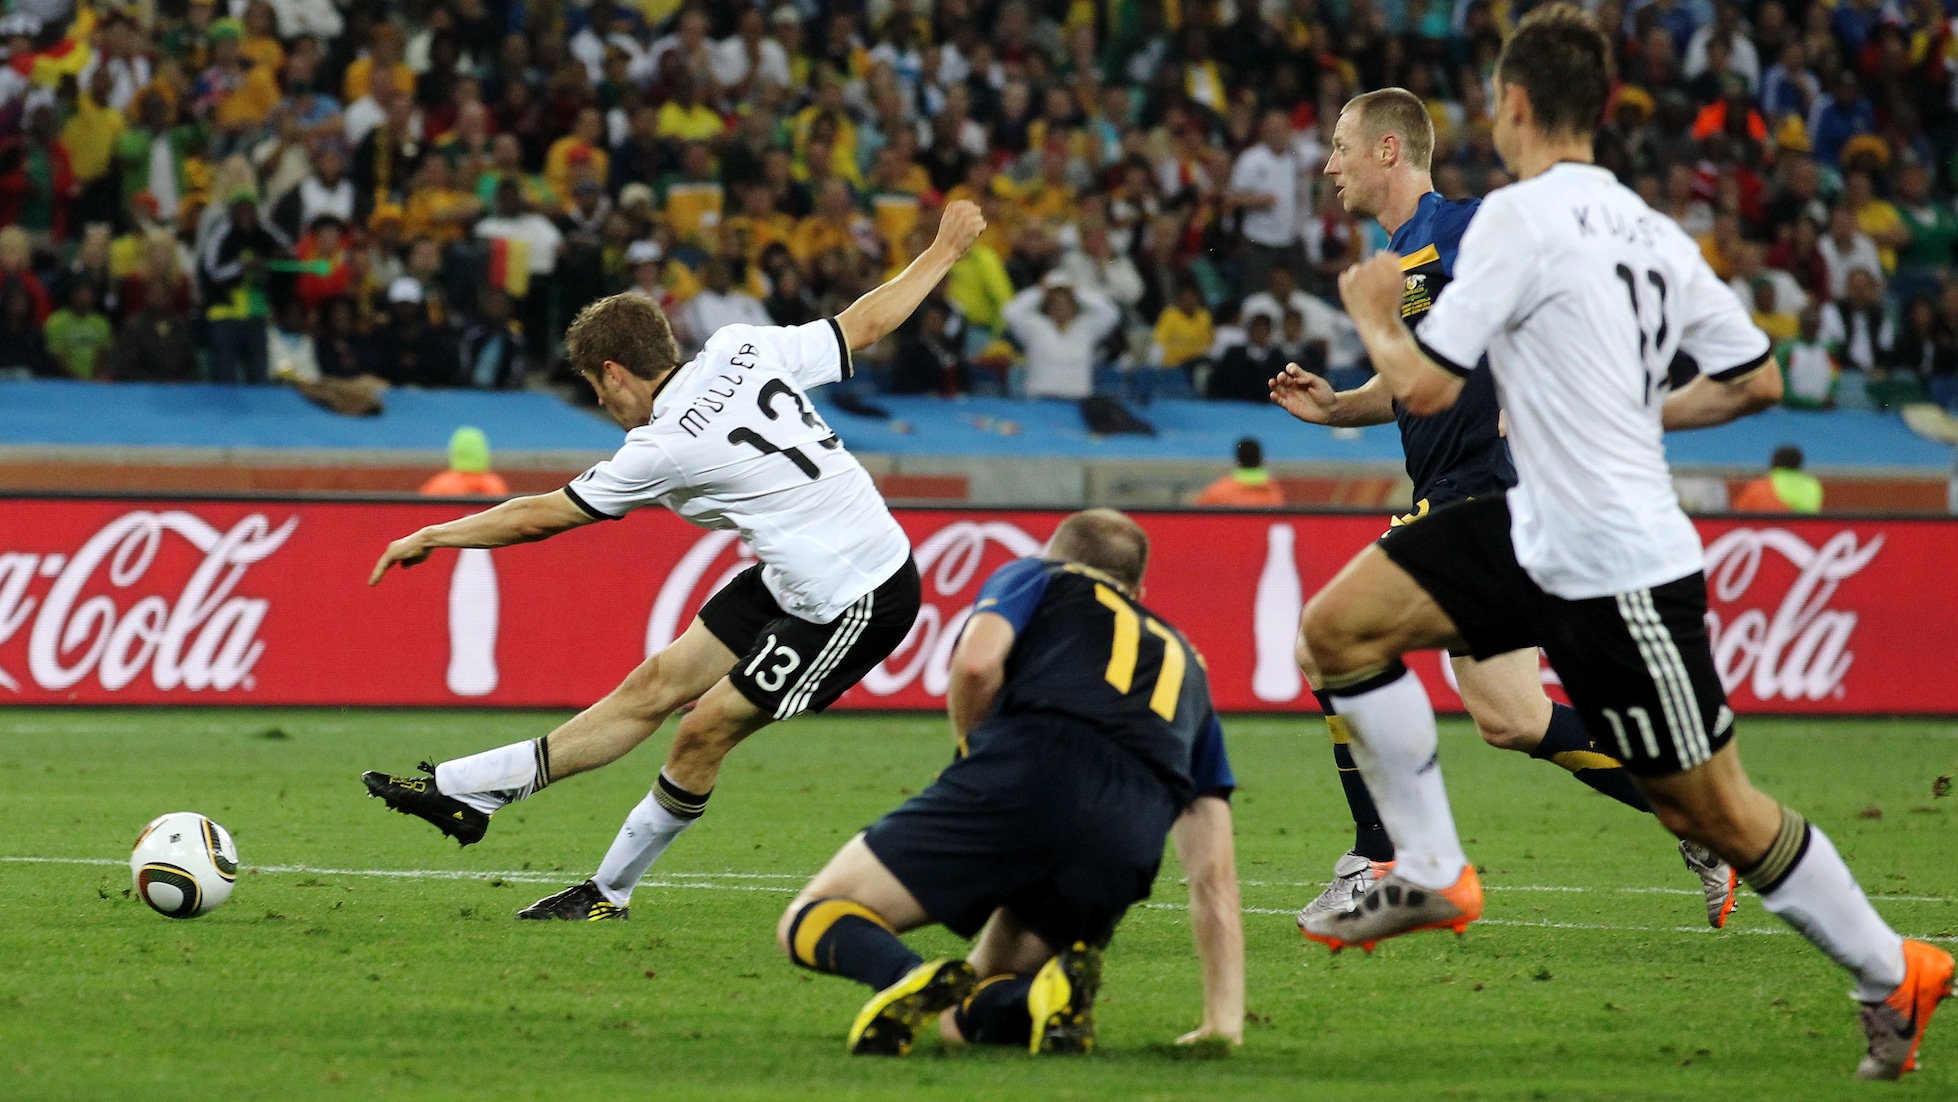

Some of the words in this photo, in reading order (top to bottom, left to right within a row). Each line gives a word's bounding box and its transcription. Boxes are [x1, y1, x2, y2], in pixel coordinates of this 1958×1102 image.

[679, 343, 760, 438] MÜLLER
[744, 633, 801, 692] 13
[1602, 706, 1660, 758] 11
